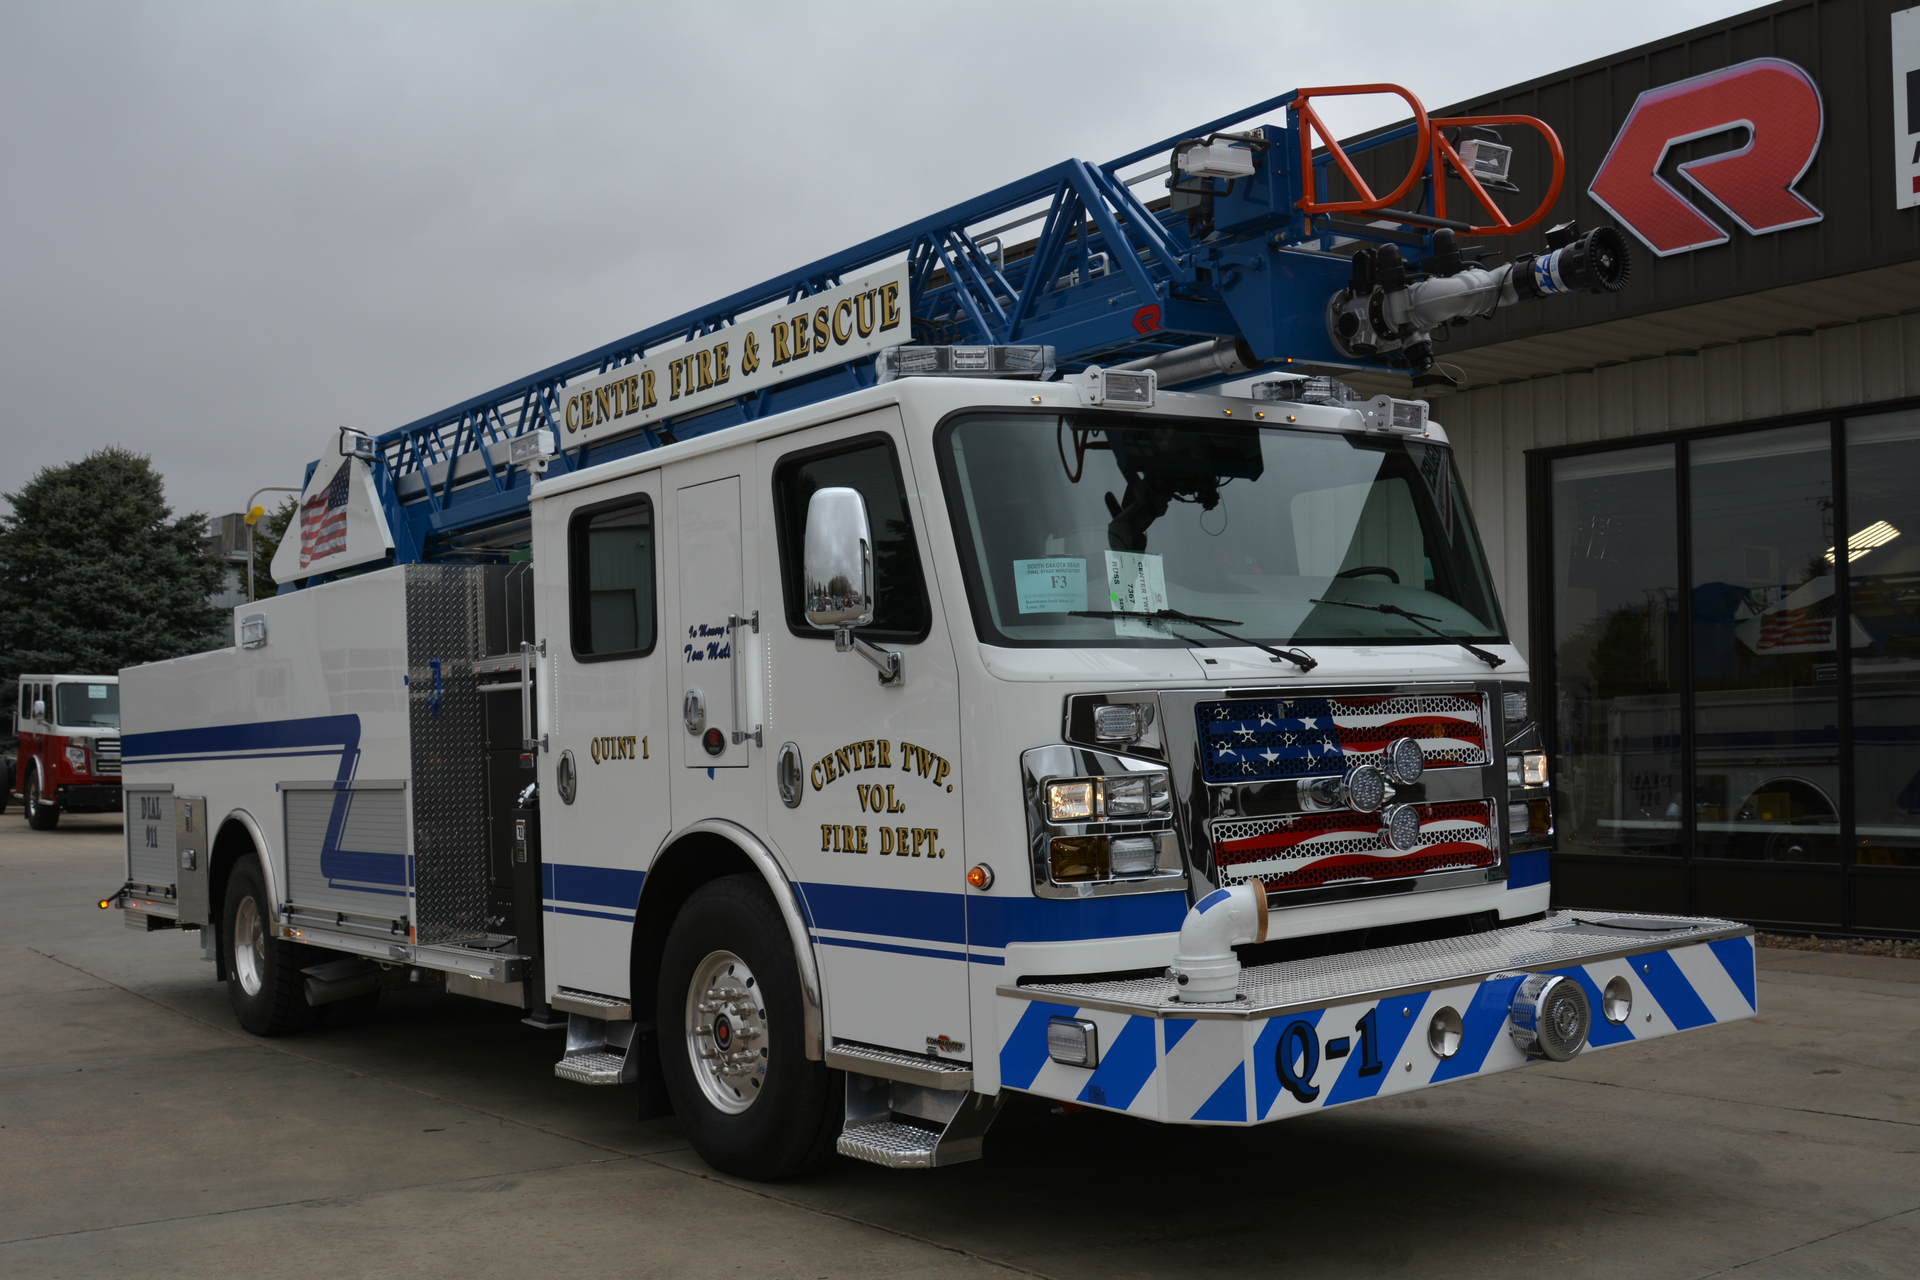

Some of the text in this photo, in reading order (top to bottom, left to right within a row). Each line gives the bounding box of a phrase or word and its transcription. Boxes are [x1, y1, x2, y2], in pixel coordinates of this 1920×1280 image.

[565, 281, 901, 434] CENTER FIRE & RESCUE
[1050, 575, 1068, 589] F3
[1112, 561, 1121, 585] RUSS
[1138, 561, 1148, 594] CENTER
[1127, 583, 1136, 604] 7367
[684, 644, 704, 663] Tom
[591, 735, 650, 765] QUINT 1
[811, 739, 953, 793] CENTER TWP.
[141, 796, 162, 820] DIAL
[857, 784, 906, 813] VOL.
[146, 825, 158, 848] 911
[821, 824, 945, 859] FIRE DEPT.
[926, 1037, 963, 1050] COMMANDER
[1275, 1007, 1383, 1104] Q-1
